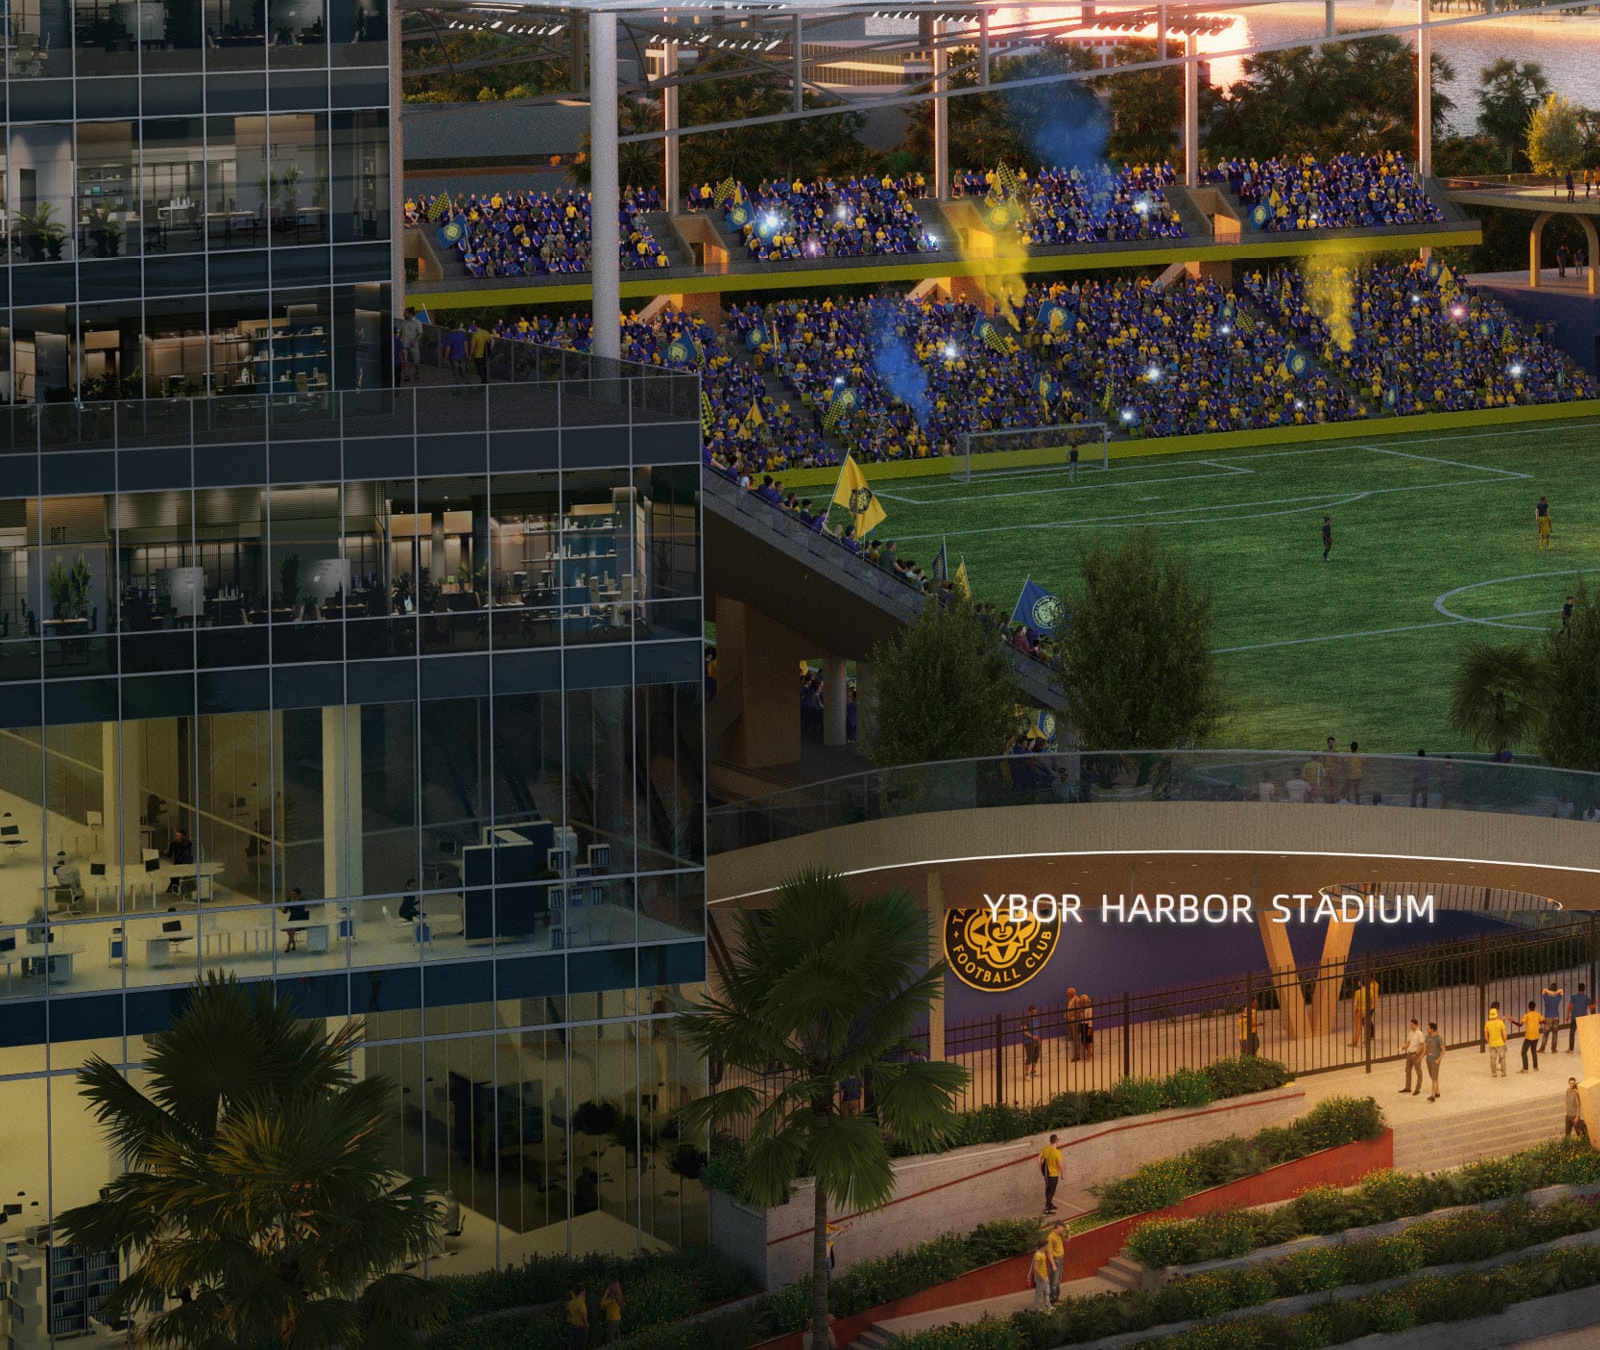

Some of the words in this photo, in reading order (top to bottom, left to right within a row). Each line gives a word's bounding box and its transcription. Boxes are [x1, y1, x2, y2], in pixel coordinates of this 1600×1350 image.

[984, 893, 1082, 923] YBOR
[1102, 893, 1253, 923] HARBOR
[1271, 893, 1435, 923] STADIUM
[952, 944, 1022, 983] FOOTBALL
[1024, 930, 1052, 969] CLUB
